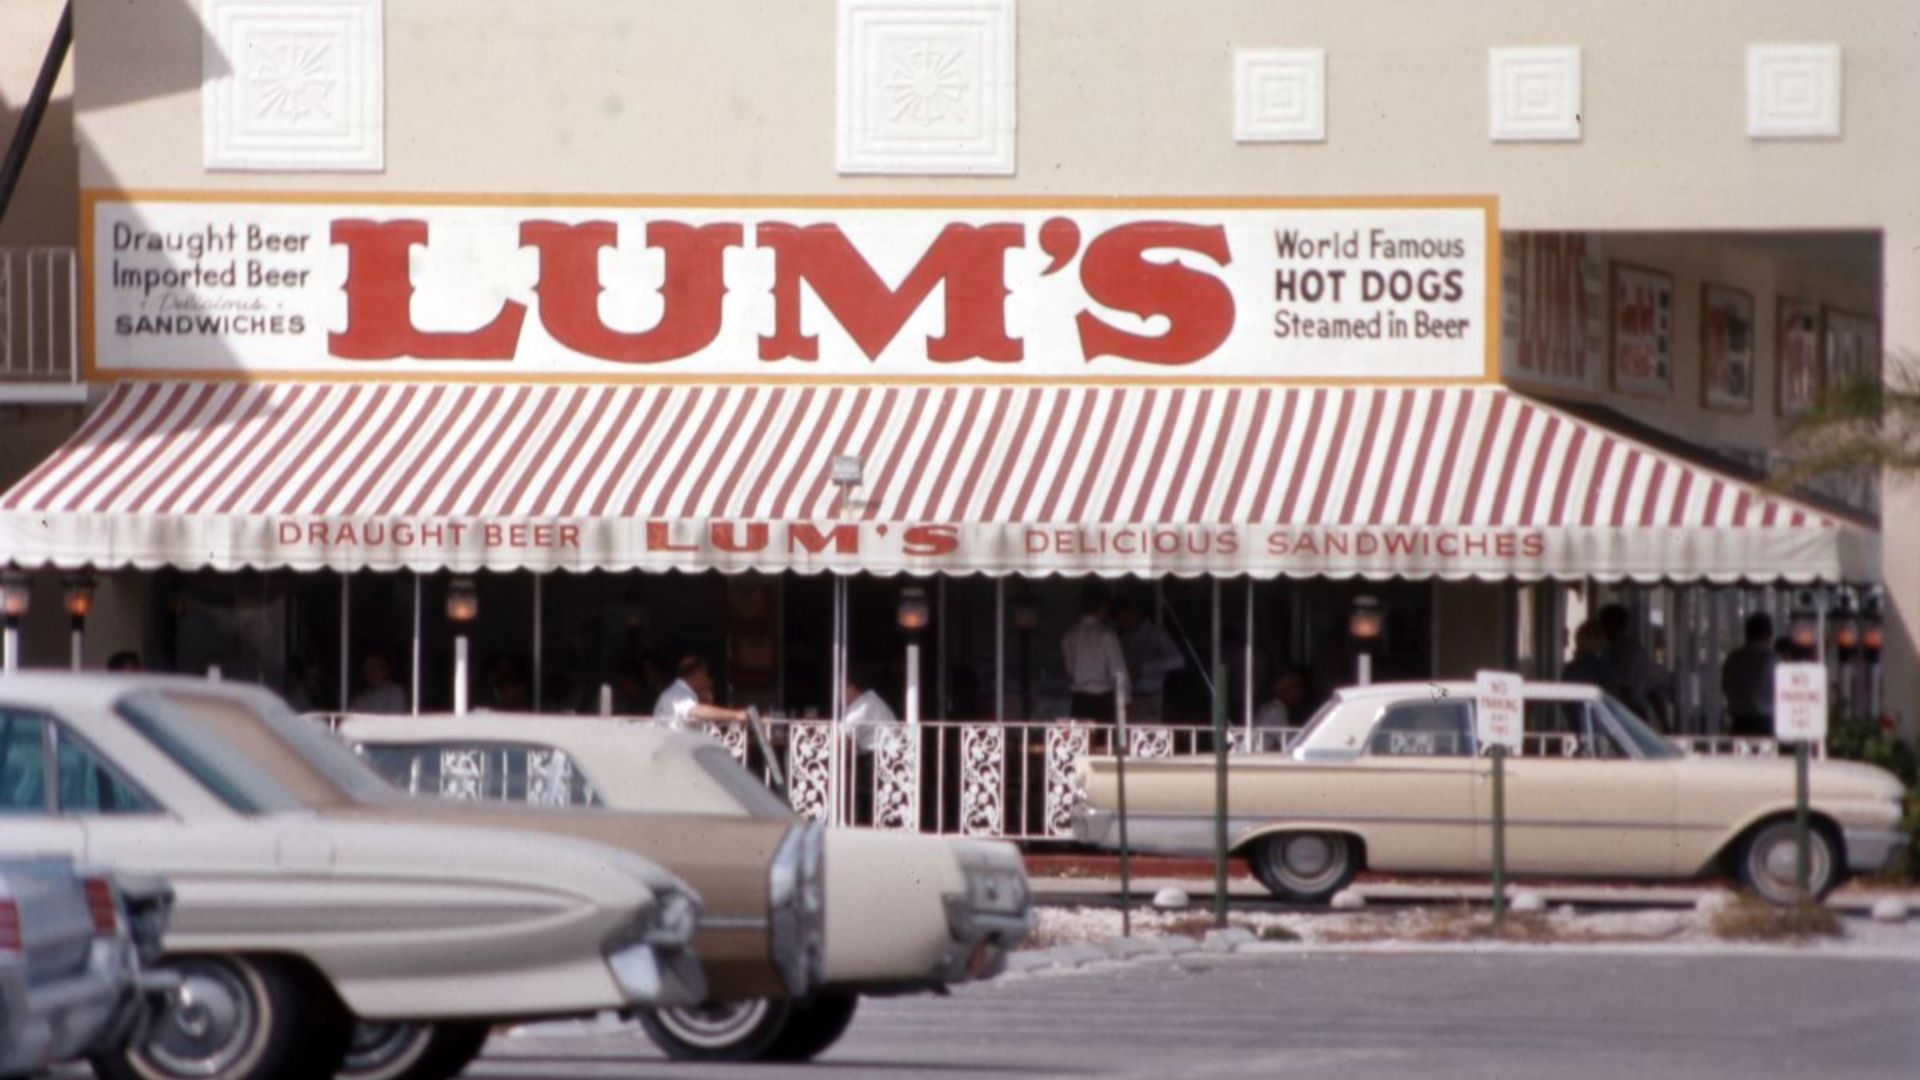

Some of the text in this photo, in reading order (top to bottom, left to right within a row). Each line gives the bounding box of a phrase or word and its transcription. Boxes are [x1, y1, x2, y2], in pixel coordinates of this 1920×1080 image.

[113, 221, 310, 258] Draught Beer
[1275, 229, 1465, 260] World Famous
[113, 260, 310, 296] Imported Beer
[1275, 269, 1464, 302] HOT DOGS
[115, 314, 306, 335] SANDWICHES
[1274, 309, 1469, 339] Steamed in Beer
[279, 522, 581, 548] DRAUGHT BEER
[646, 521, 960, 557] LUM'S
[1024, 530, 1545, 557] DELICIOUS SANDWICHES
